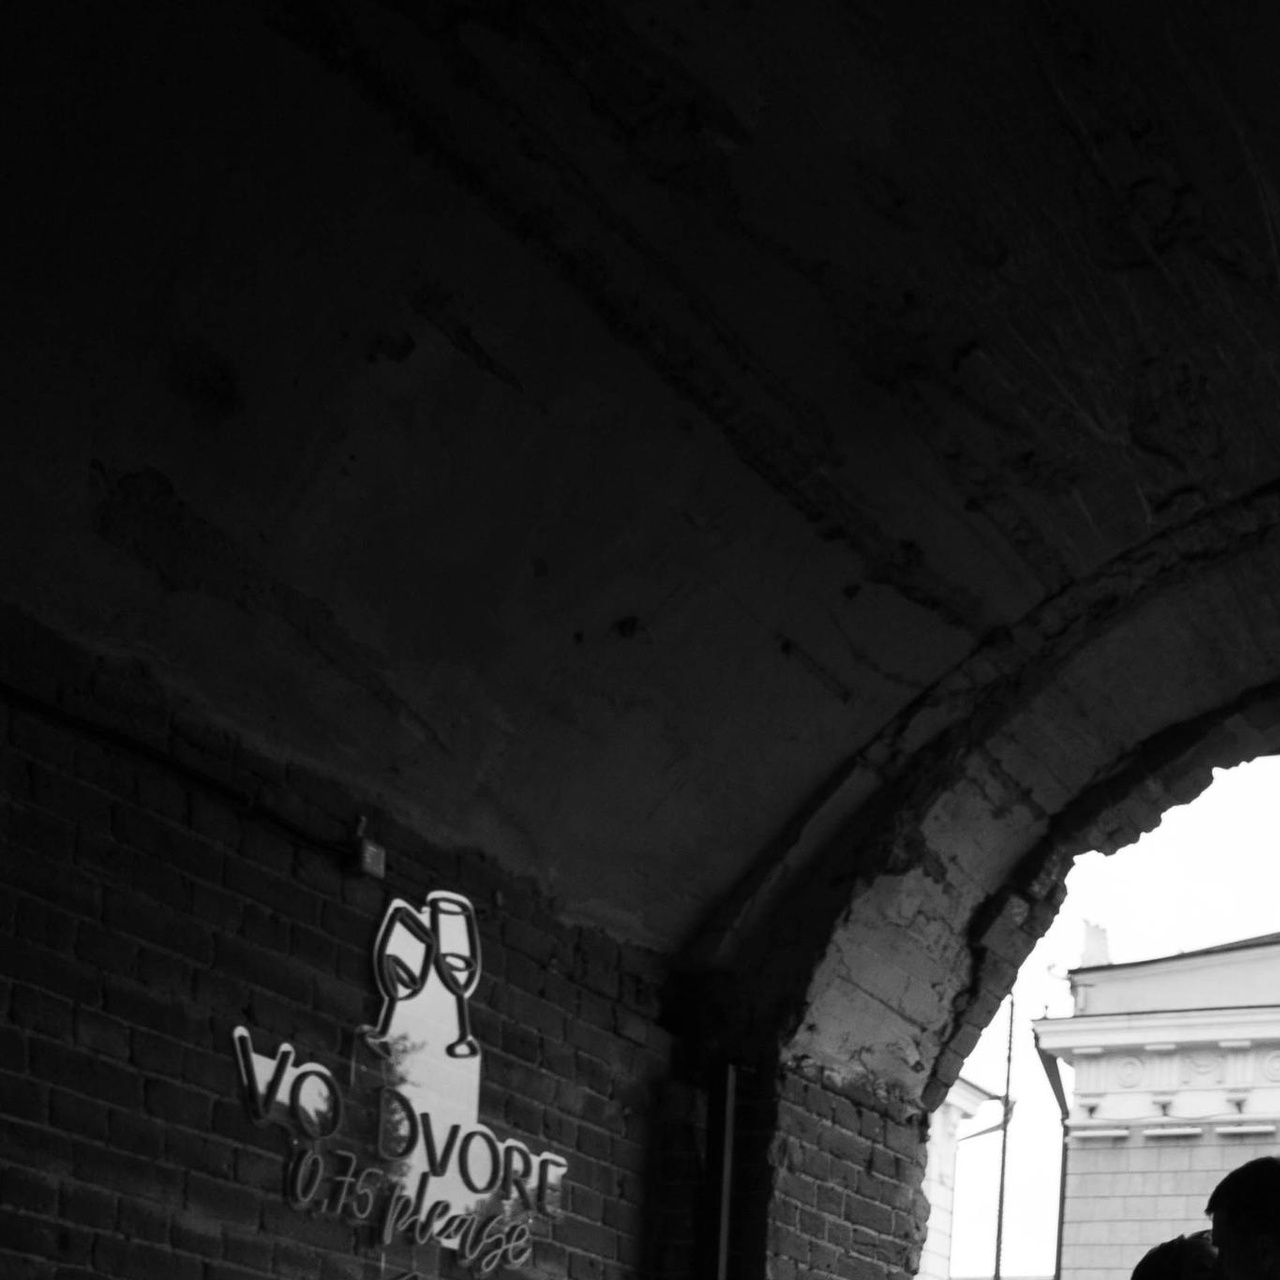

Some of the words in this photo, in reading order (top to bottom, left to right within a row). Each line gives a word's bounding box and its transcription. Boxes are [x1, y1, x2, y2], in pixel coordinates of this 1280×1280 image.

[232, 1030, 341, 1139] VO
[377, 1086, 567, 1217] DVORE
[382, 1170, 534, 1273] please
